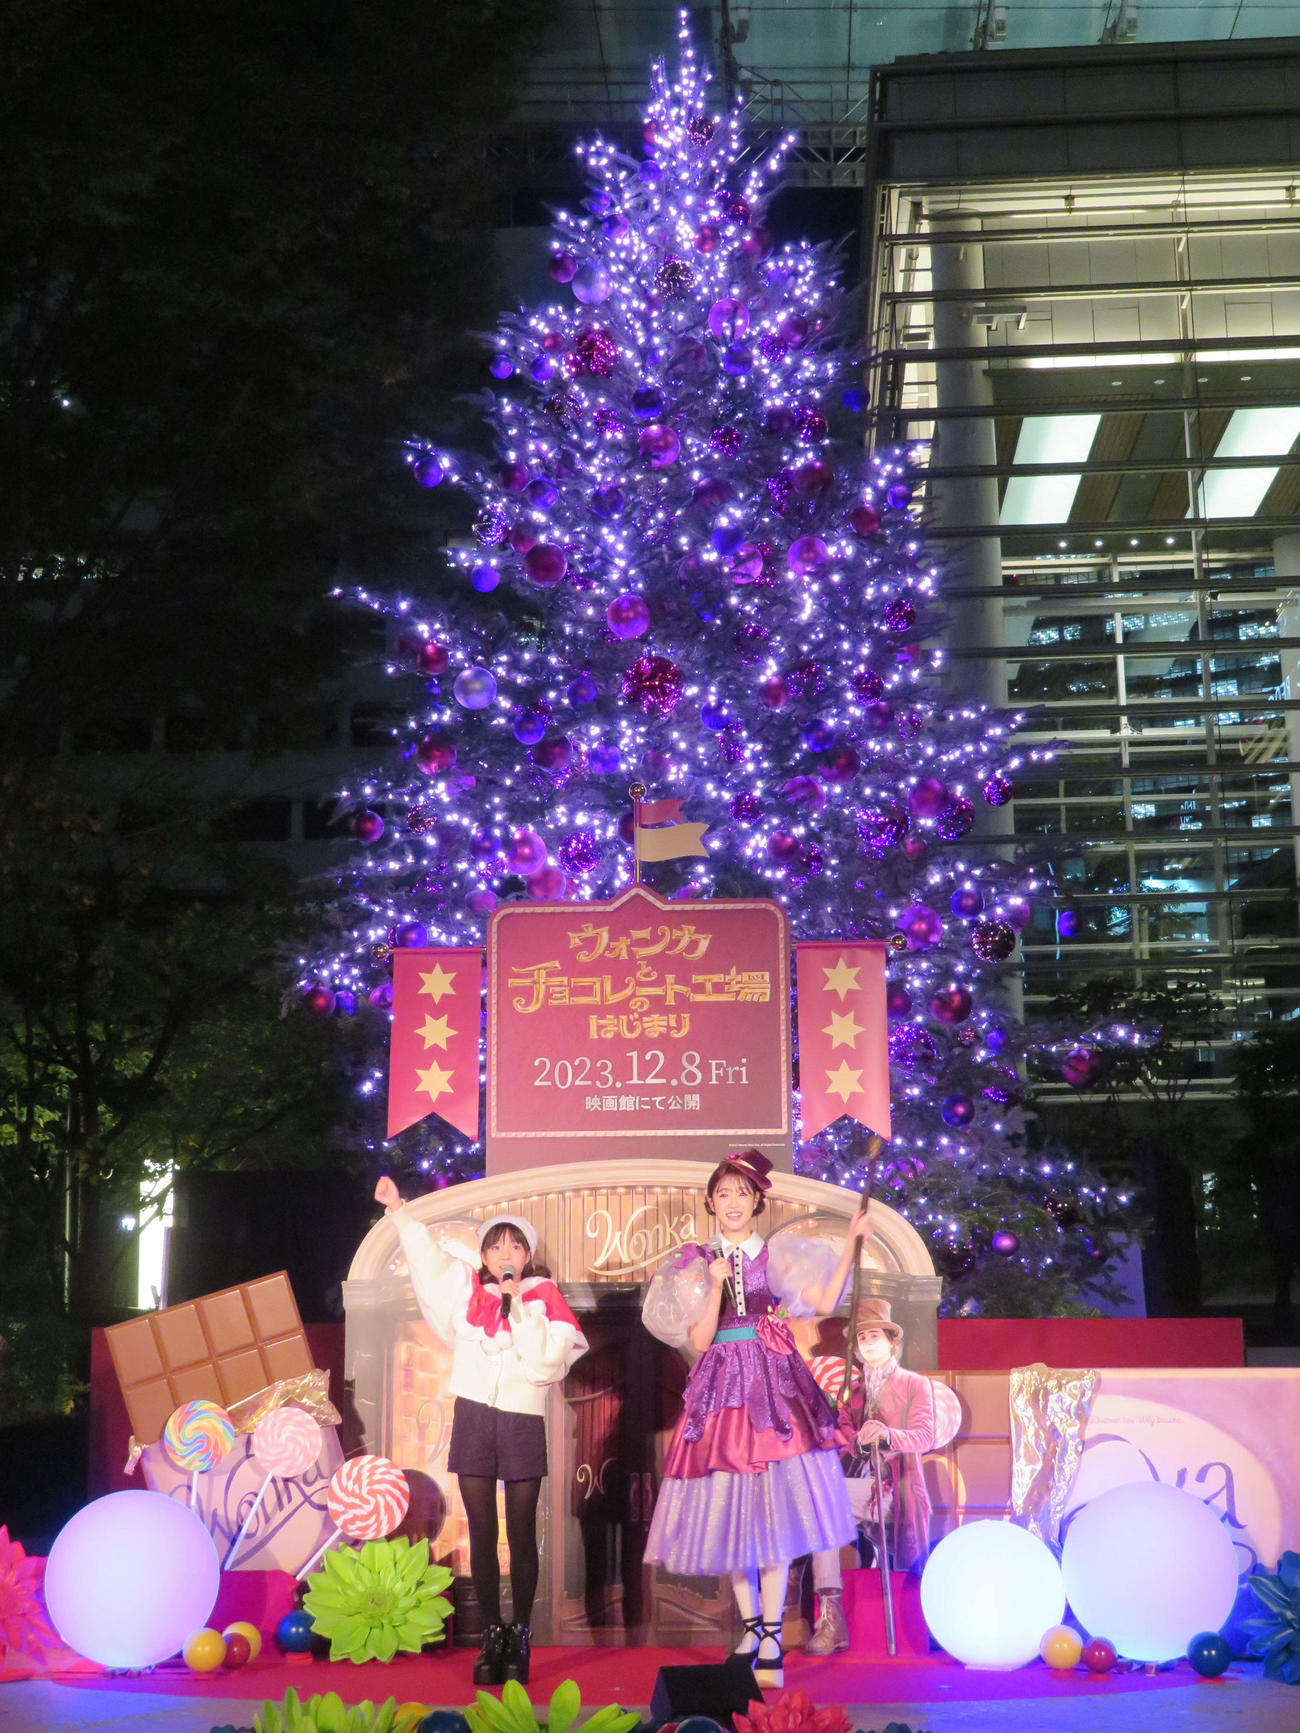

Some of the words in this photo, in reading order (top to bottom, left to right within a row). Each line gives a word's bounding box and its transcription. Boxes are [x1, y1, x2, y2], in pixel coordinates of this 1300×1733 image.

[567, 923, 713, 962] ウォンカ
[508, 960, 771, 1014] チョコレート工場
[589, 1012, 691, 1040] はじまり
[533, 1050, 703, 1089] 2023.12.8
[708, 1057, 749, 1085] Fri
[585, 1094, 701, 1112] 映画館にて公開
[586, 1206, 699, 1273] Wonka
